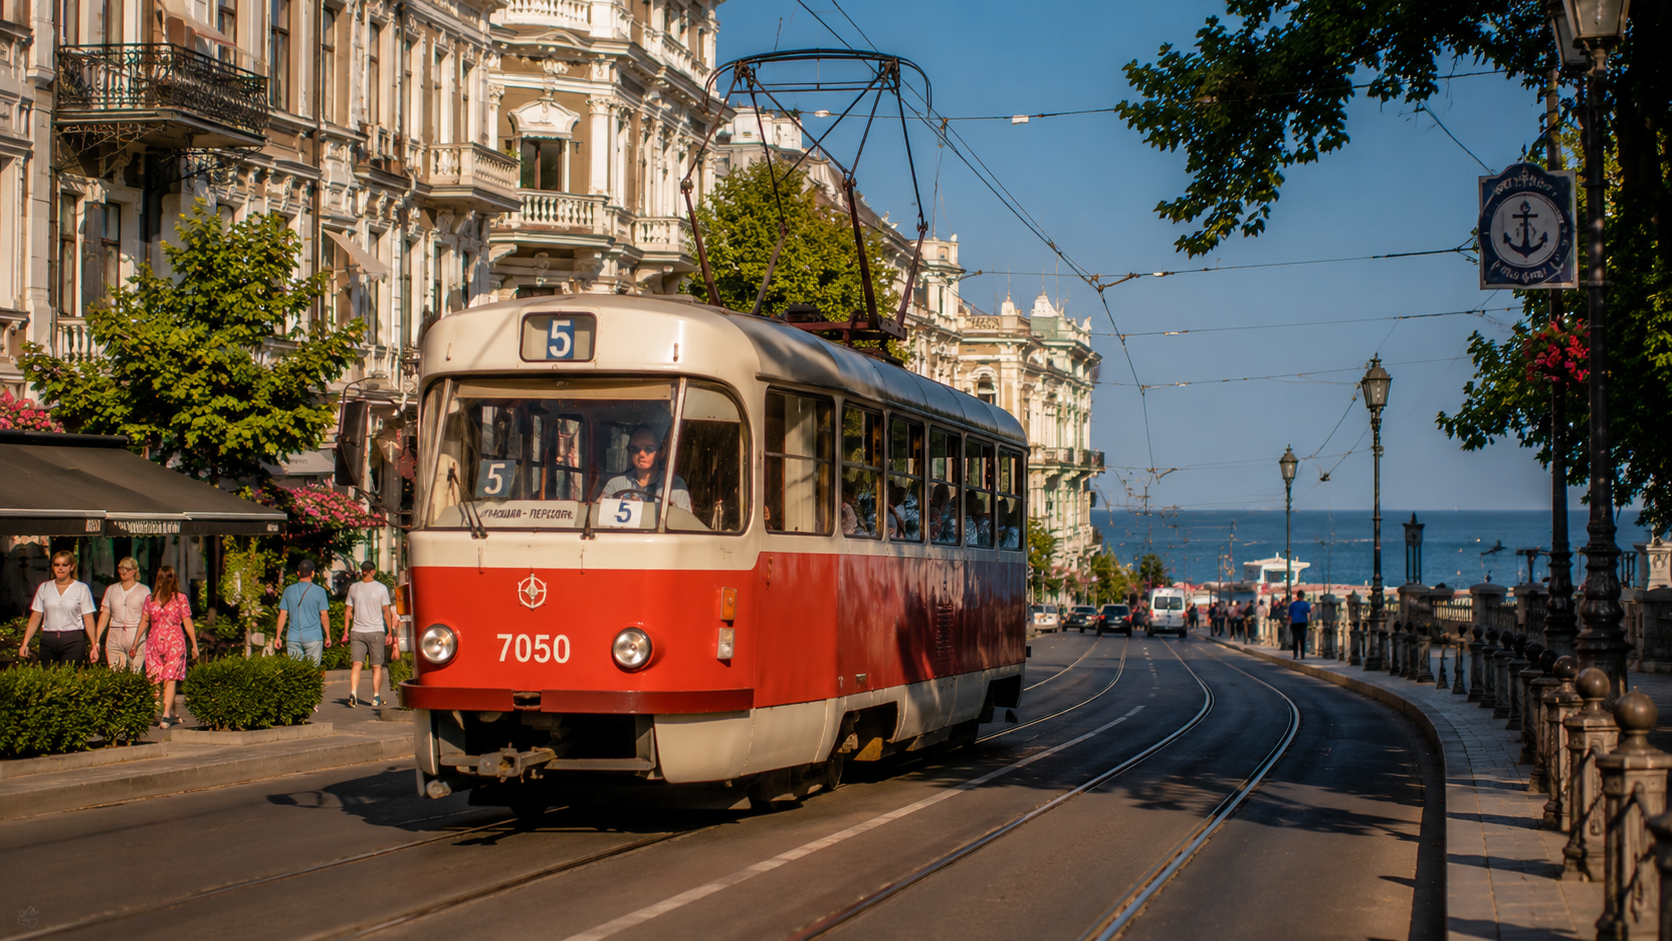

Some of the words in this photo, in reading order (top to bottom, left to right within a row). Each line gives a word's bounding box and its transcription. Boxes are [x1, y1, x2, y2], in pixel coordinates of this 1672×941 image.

[549, 319, 572, 358] 5
[484, 463, 506, 495] 5
[615, 500, 632, 523] 5
[497, 633, 571, 664] 7050
